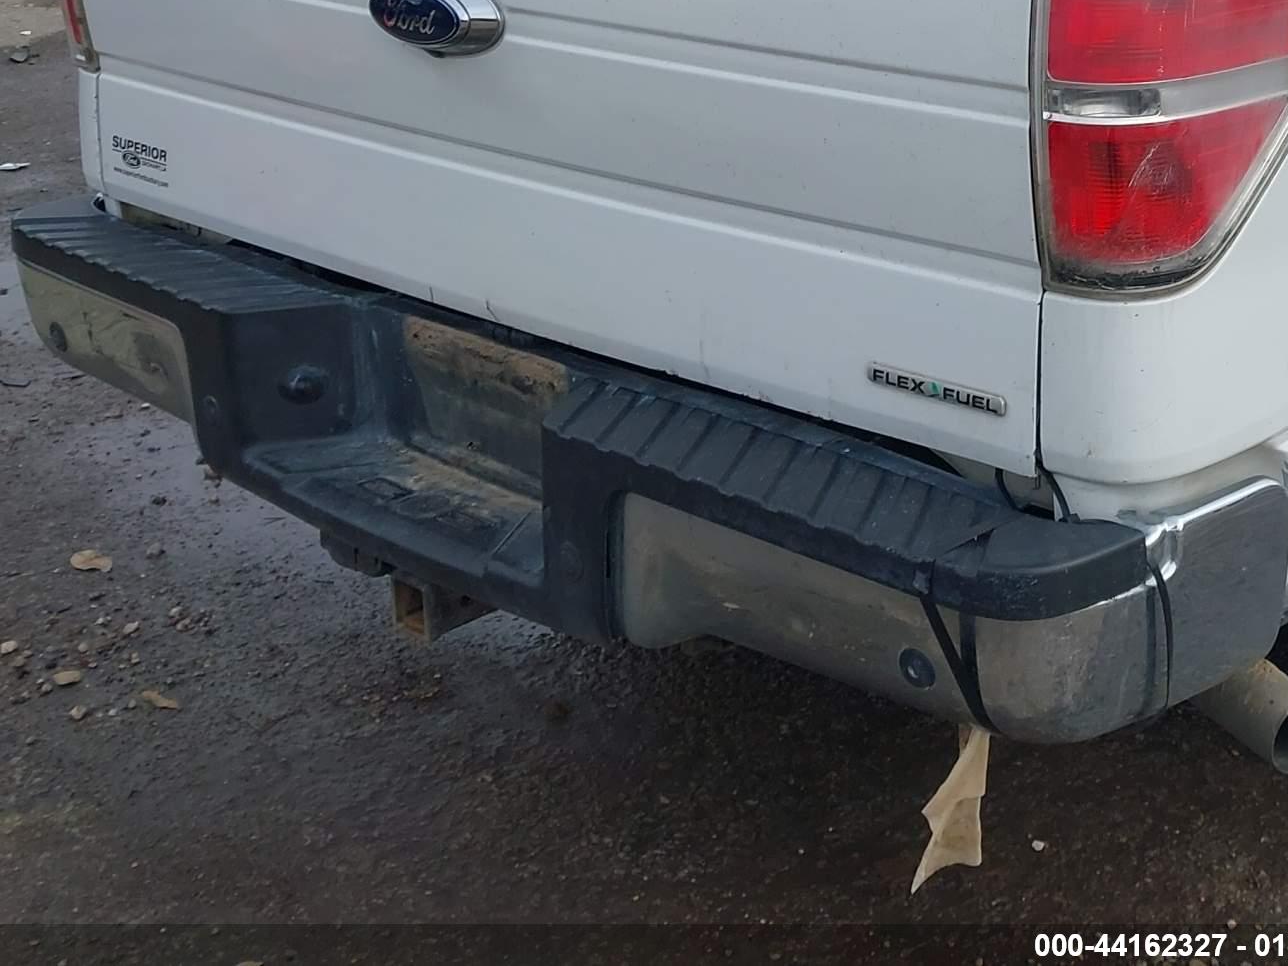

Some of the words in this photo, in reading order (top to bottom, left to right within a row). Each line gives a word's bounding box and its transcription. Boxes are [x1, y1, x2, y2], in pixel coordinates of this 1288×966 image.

[112, 135, 167, 162] SUPERIOR
[872, 368, 925, 394] FLEX
[942, 386, 998, 414] FUEL
